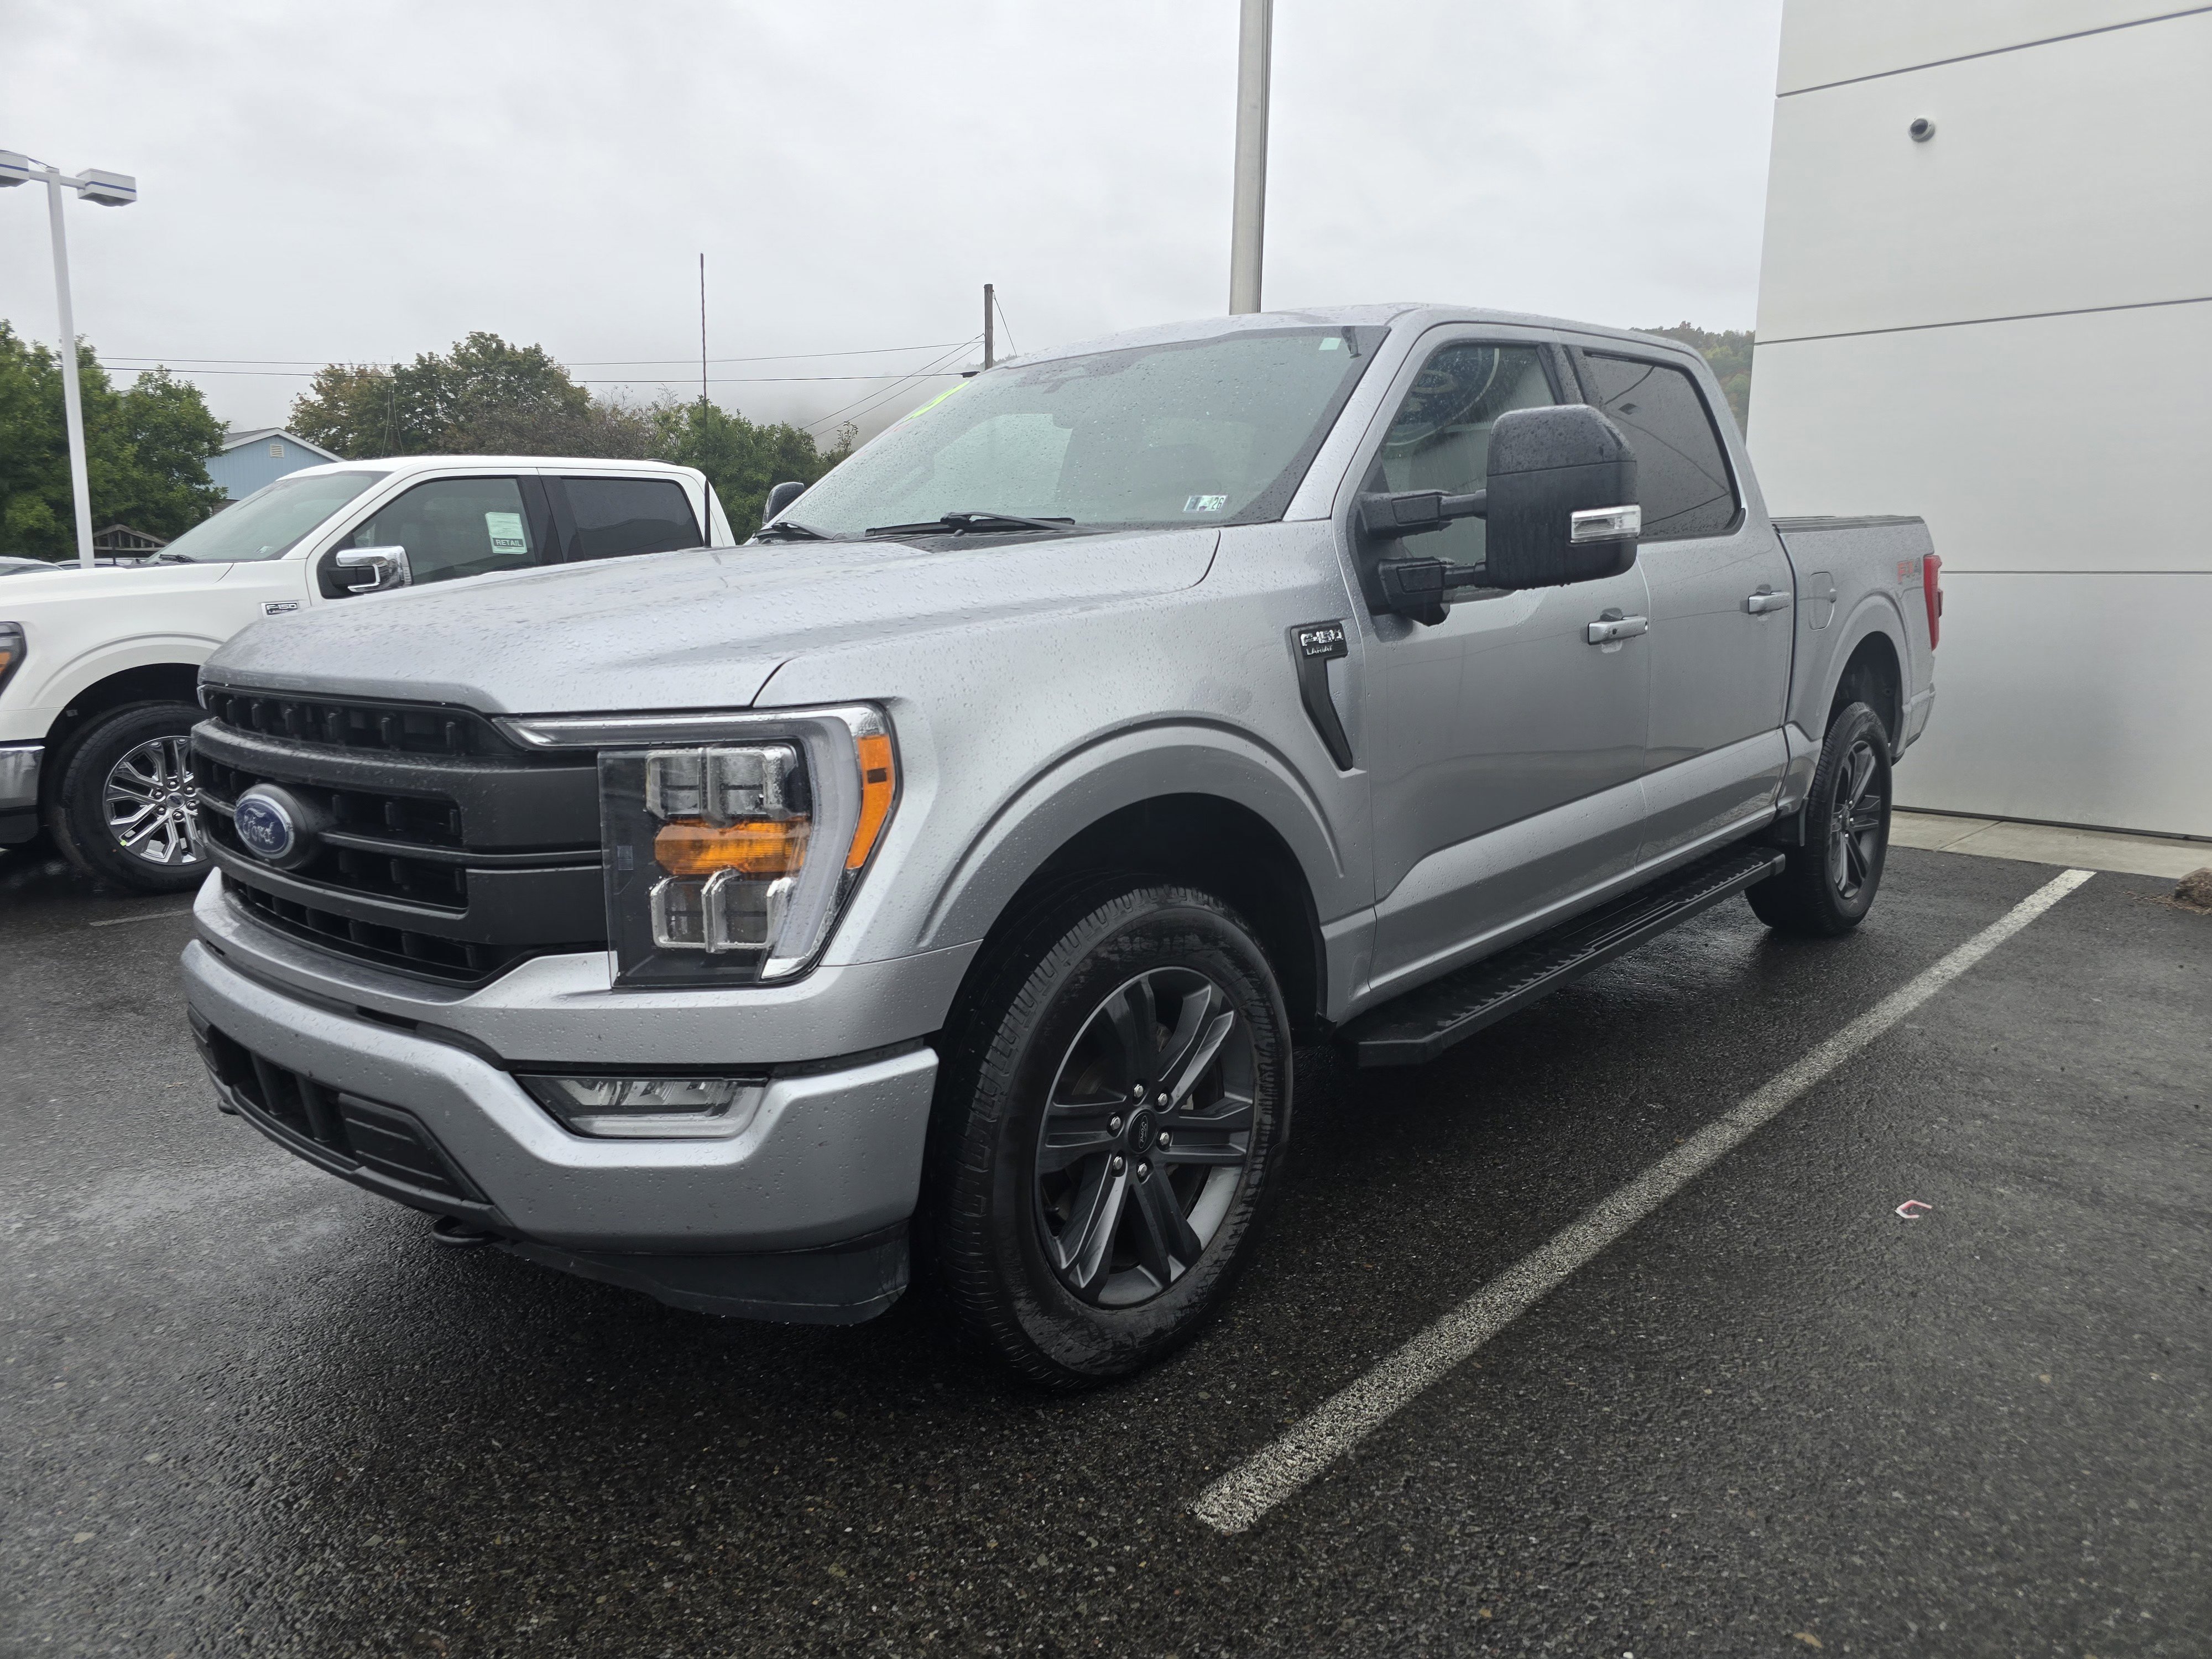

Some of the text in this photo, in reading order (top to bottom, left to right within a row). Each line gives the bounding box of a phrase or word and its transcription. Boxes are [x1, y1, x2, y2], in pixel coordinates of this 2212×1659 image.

[1211, 497, 1224, 510] 26
[1306, 644, 1333, 655] LARIAT
[242, 807, 275, 845] Ford
